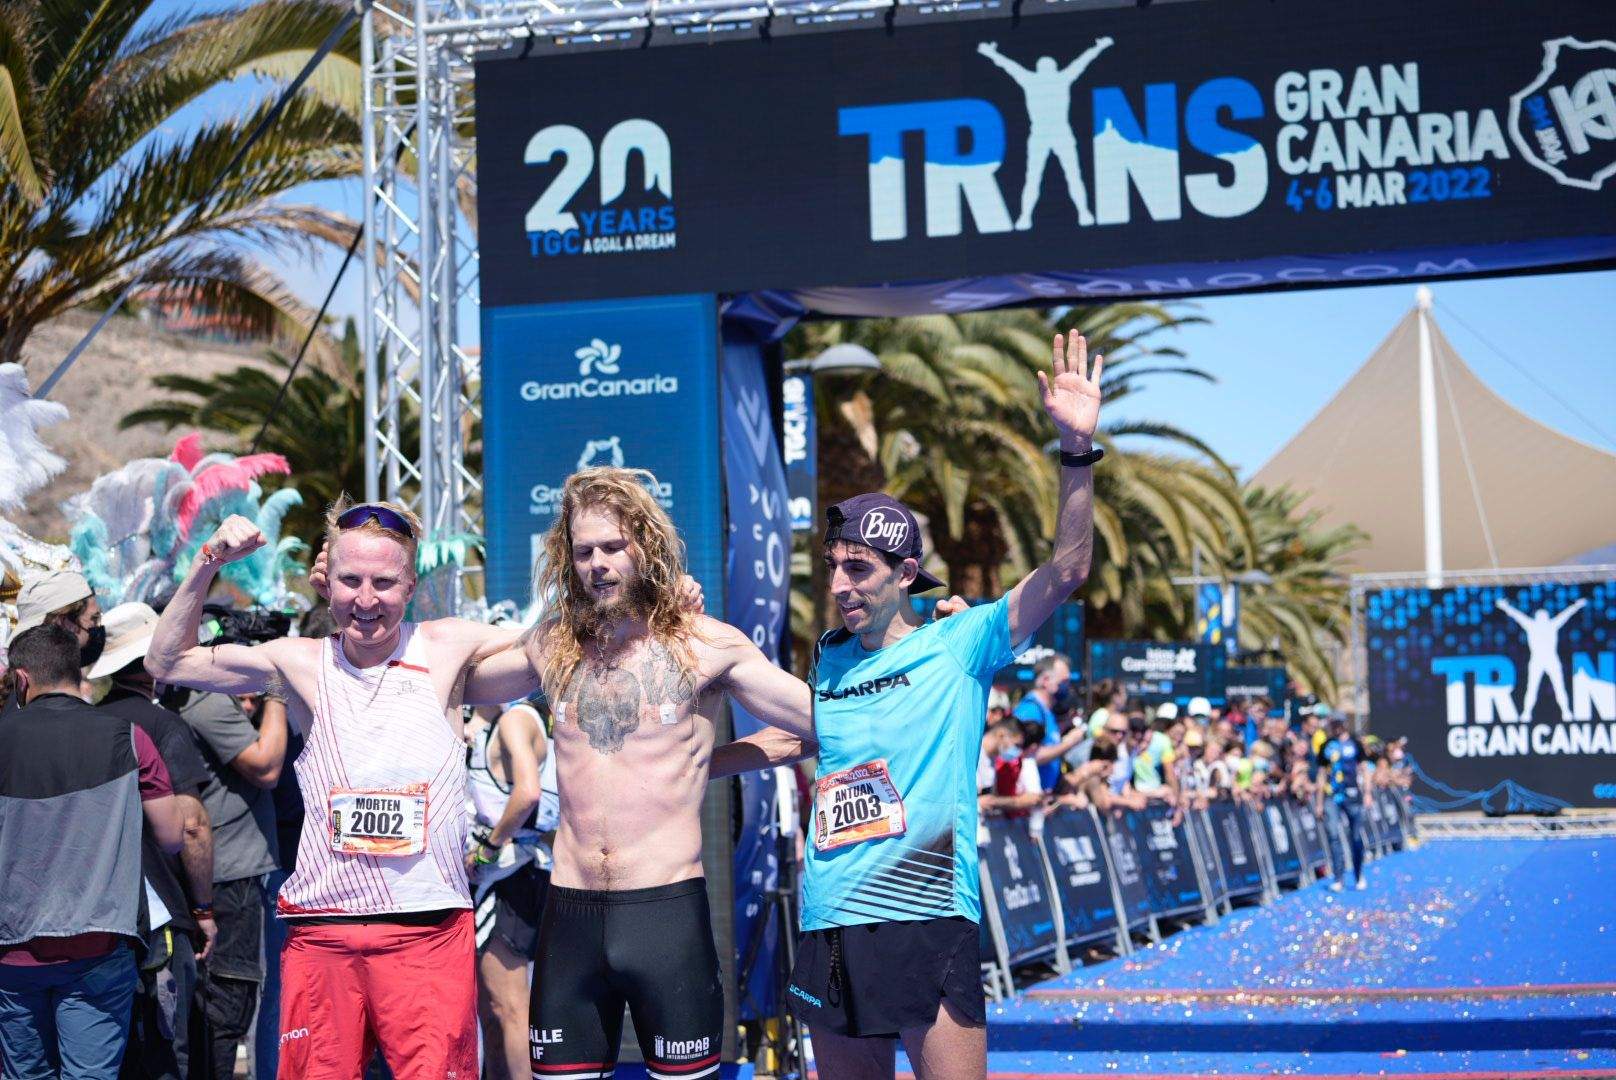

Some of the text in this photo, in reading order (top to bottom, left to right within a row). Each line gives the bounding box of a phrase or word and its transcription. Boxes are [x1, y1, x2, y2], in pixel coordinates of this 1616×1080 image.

[1274, 62, 1420, 123] GRAN
[838, 36, 1268, 241] TRANS
[1276, 108, 1511, 176] CANARIA
[523, 118, 673, 233] 20
[1286, 166, 1492, 213] 4-6 MAR 2022
[580, 205, 677, 237] YEARS
[526, 228, 582, 257] TGC
[582, 238, 593, 255] A
[593, 235, 624, 254] GOAL
[634, 232, 677, 251] DREAM
[520, 373, 679, 402] GranCanaria
[818, 673, 911, 702] SCARPA
[1447, 725, 1529, 758] GRAN
[355, 797, 401, 811] MORTEN
[834, 782, 875, 804] ANTUAN
[350, 811, 404, 835] 2002
[832, 794, 883, 828] 2003
[789, 983, 822, 1009] SCARPA
[278, 1027, 309, 1050] mon
[532, 1045, 545, 1060] IF
[666, 1036, 710, 1055] IMPAB
